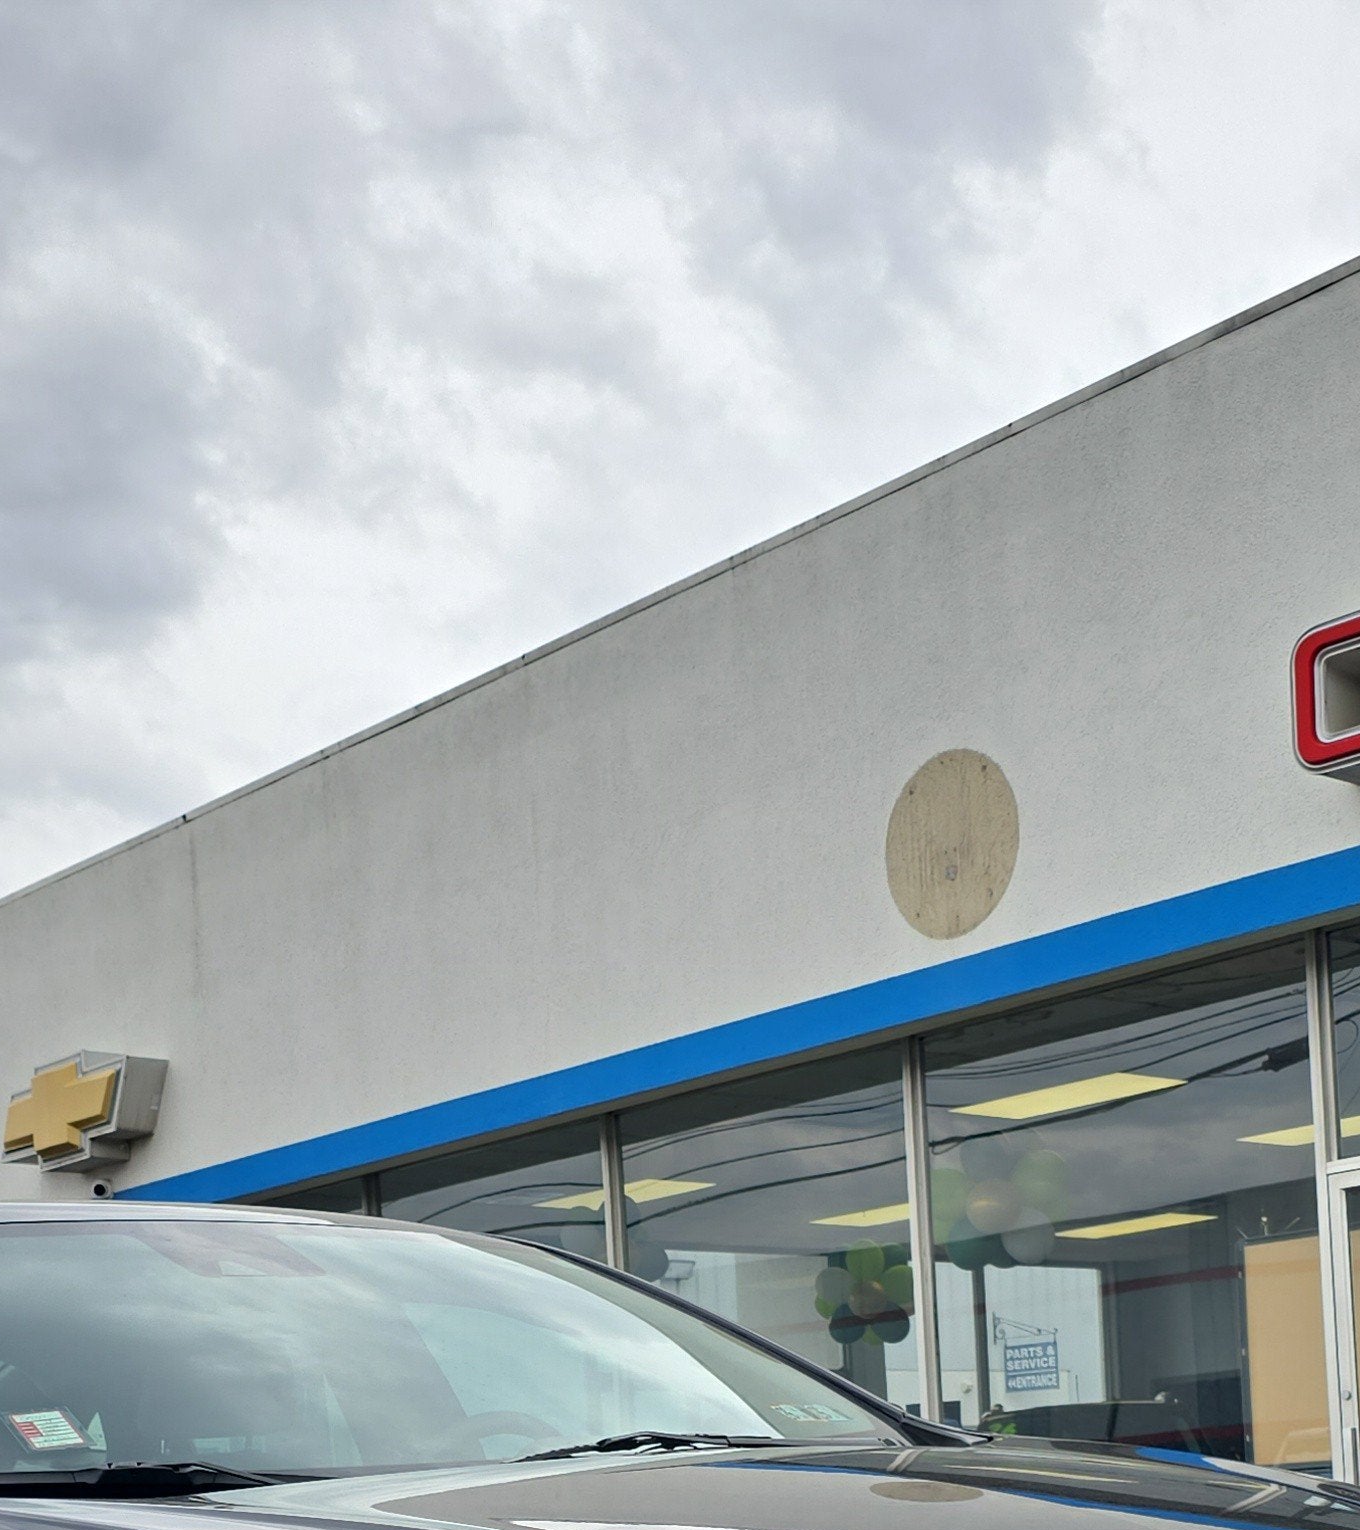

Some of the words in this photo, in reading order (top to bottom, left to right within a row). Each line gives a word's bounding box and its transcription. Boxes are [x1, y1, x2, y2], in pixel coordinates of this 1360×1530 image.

[1006, 1346, 1044, 1360] PARTS
[1046, 1345, 1056, 1356] &
[1006, 1356, 1056, 1370] SERVICE
